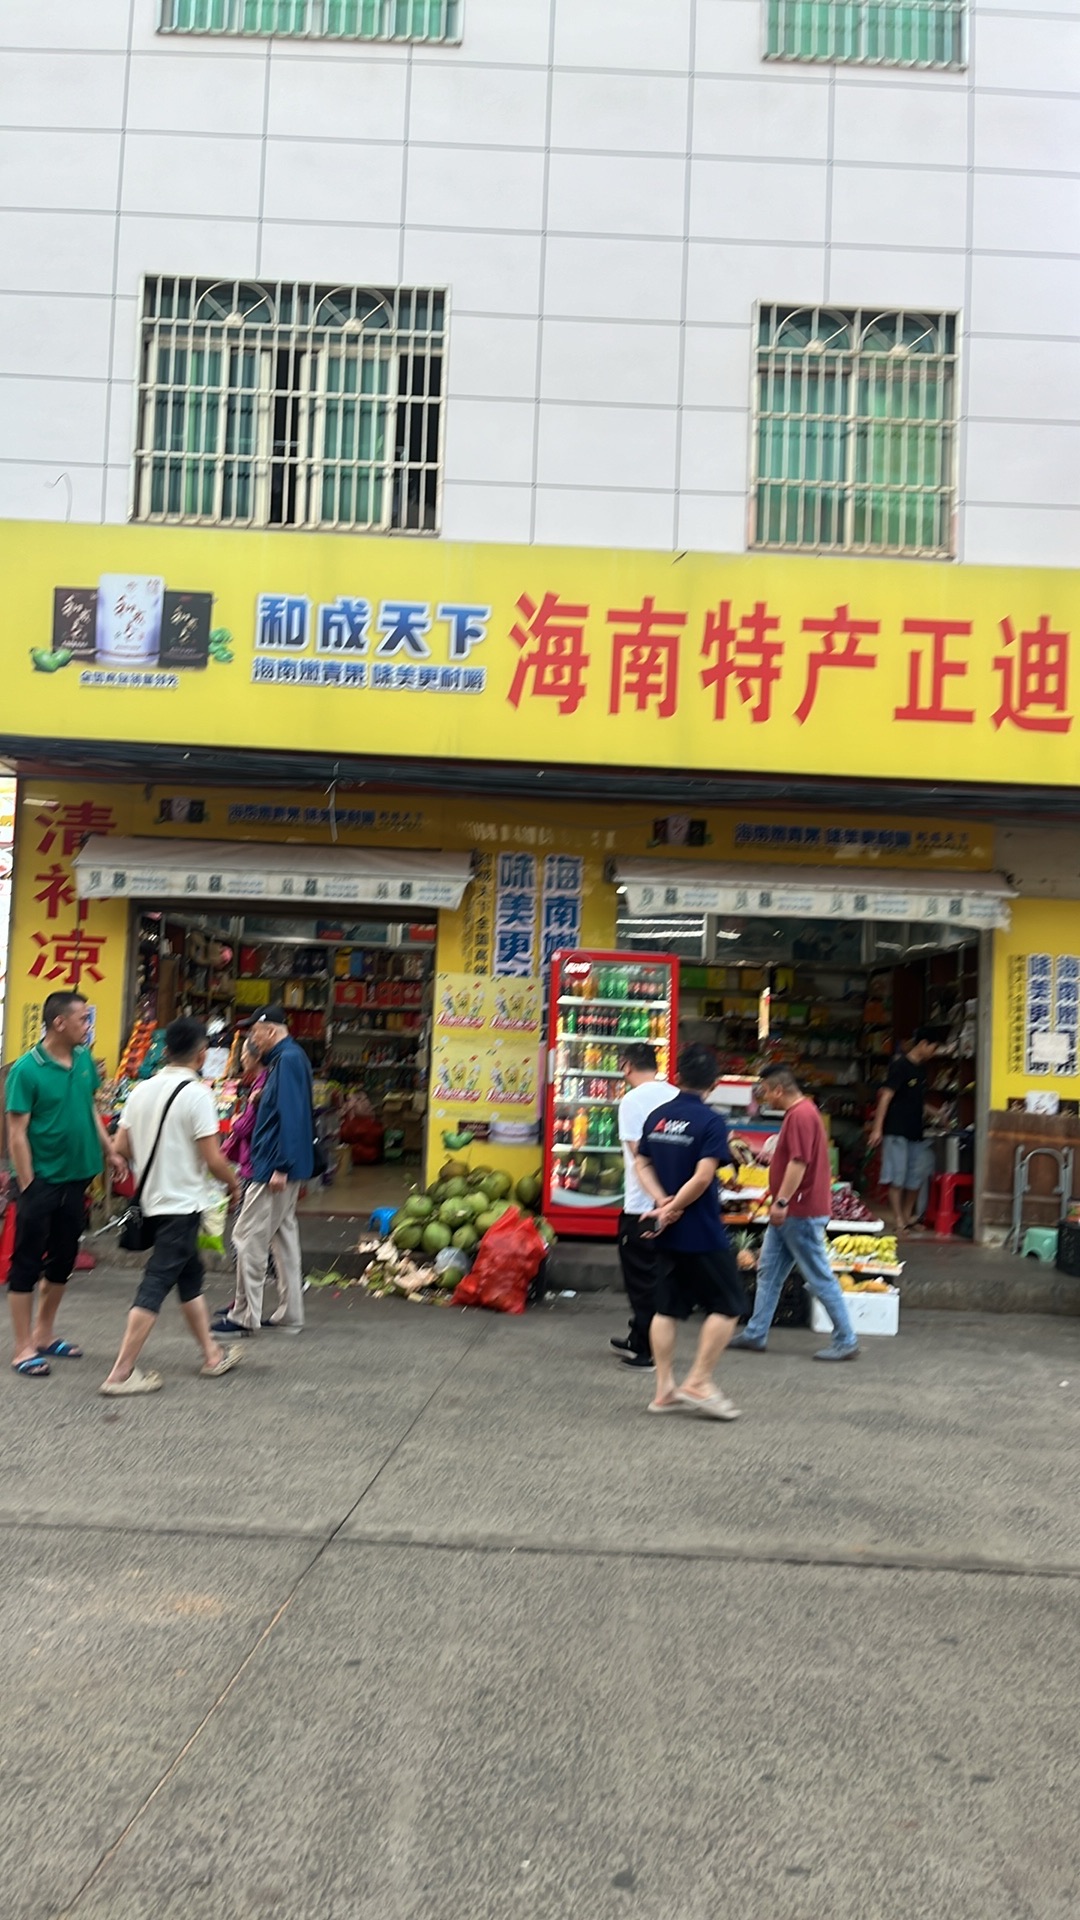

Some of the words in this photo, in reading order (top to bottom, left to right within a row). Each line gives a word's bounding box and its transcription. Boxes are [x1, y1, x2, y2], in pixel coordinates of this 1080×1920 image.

[257, 594, 490, 659] 和成天下
[505, 591, 1074, 734] 海南特产正迪
[497, 853, 535, 978] 味美更
